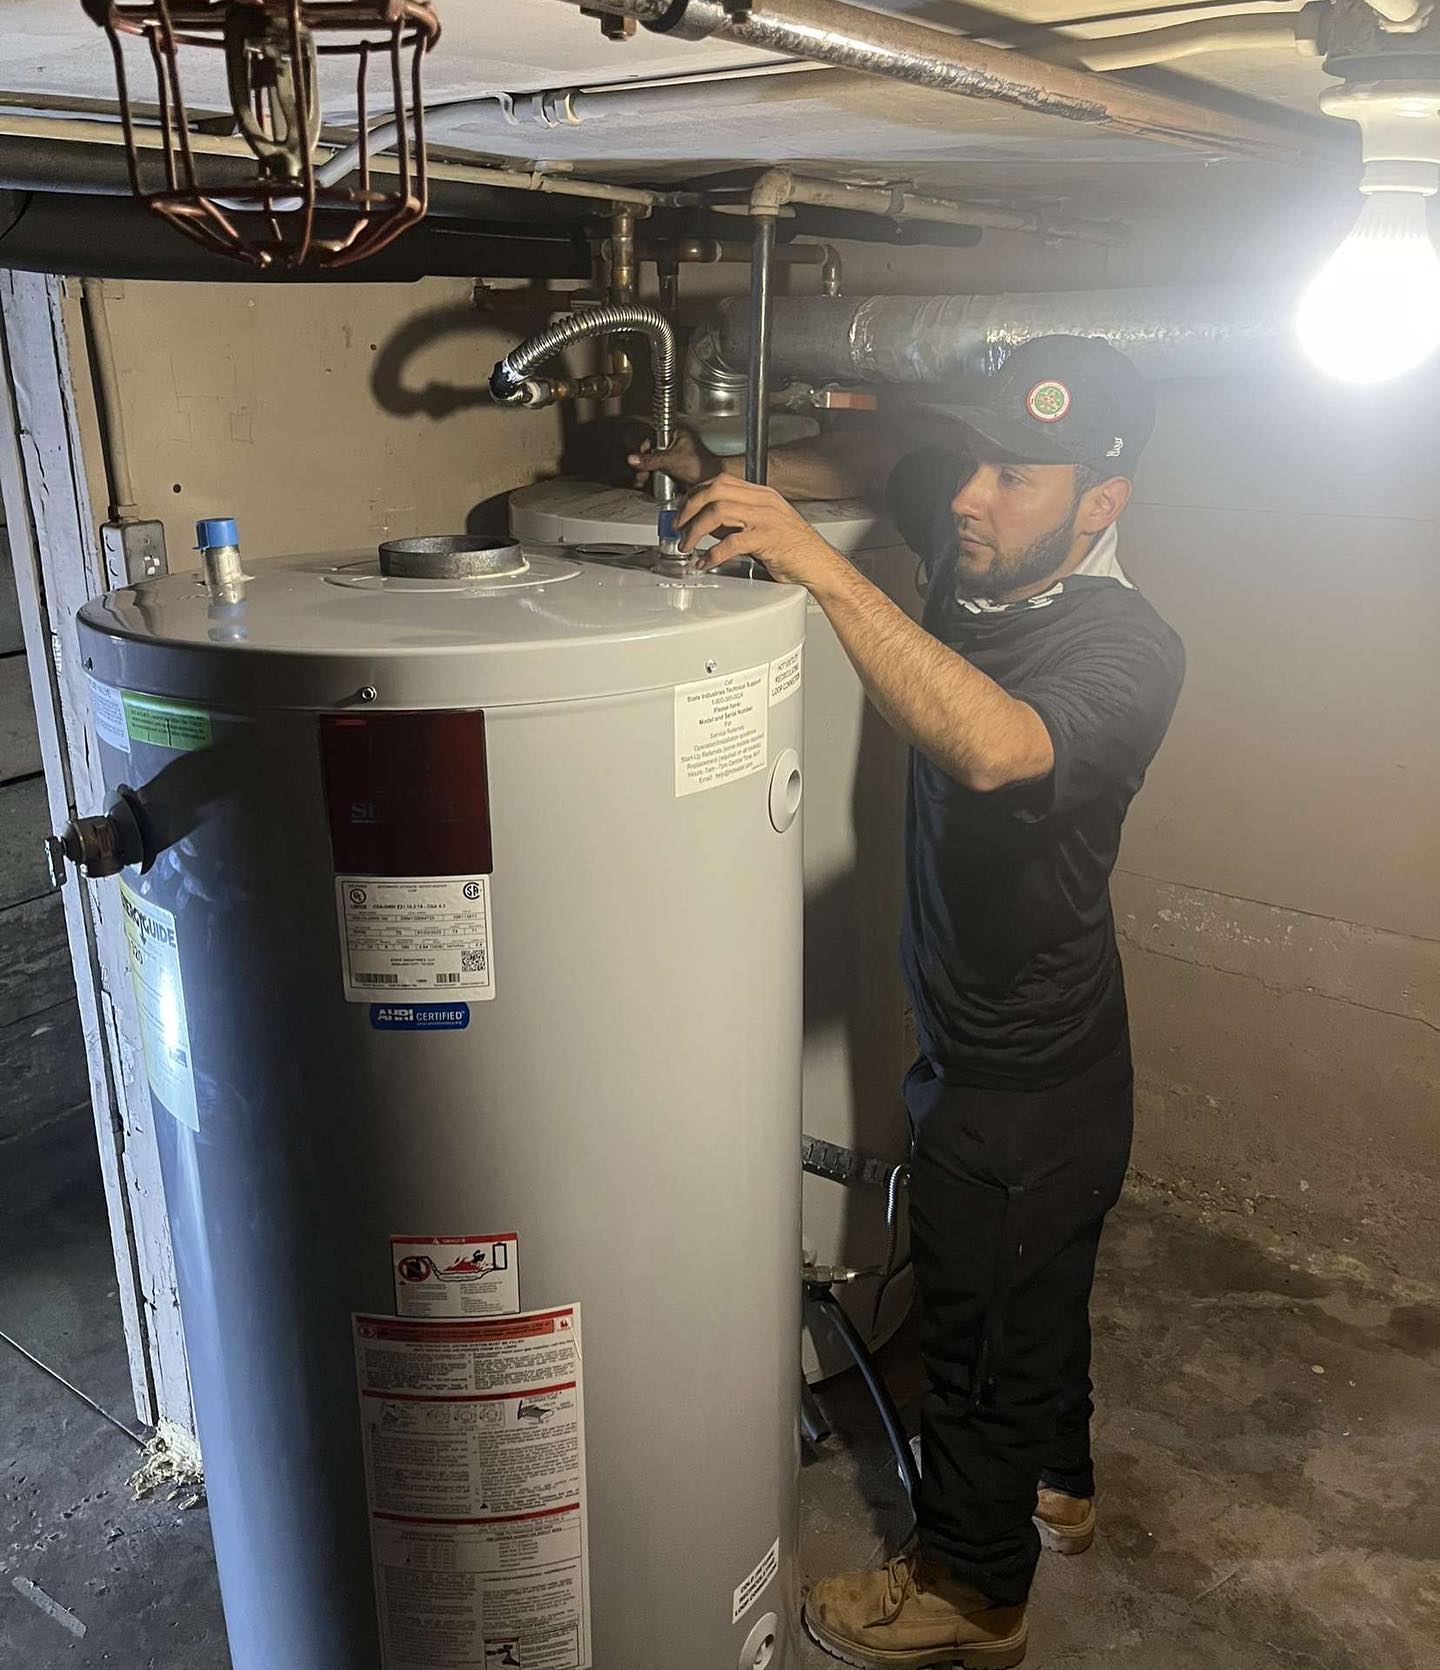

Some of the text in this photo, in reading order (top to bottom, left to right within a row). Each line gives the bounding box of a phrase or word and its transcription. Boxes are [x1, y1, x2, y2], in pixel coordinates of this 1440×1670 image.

[687, 679, 761, 702] State Industries Technical Support
[699, 706, 753, 725] Model and Serial Number
[378, 1008, 463, 1022] AHRI CERTIFIED
